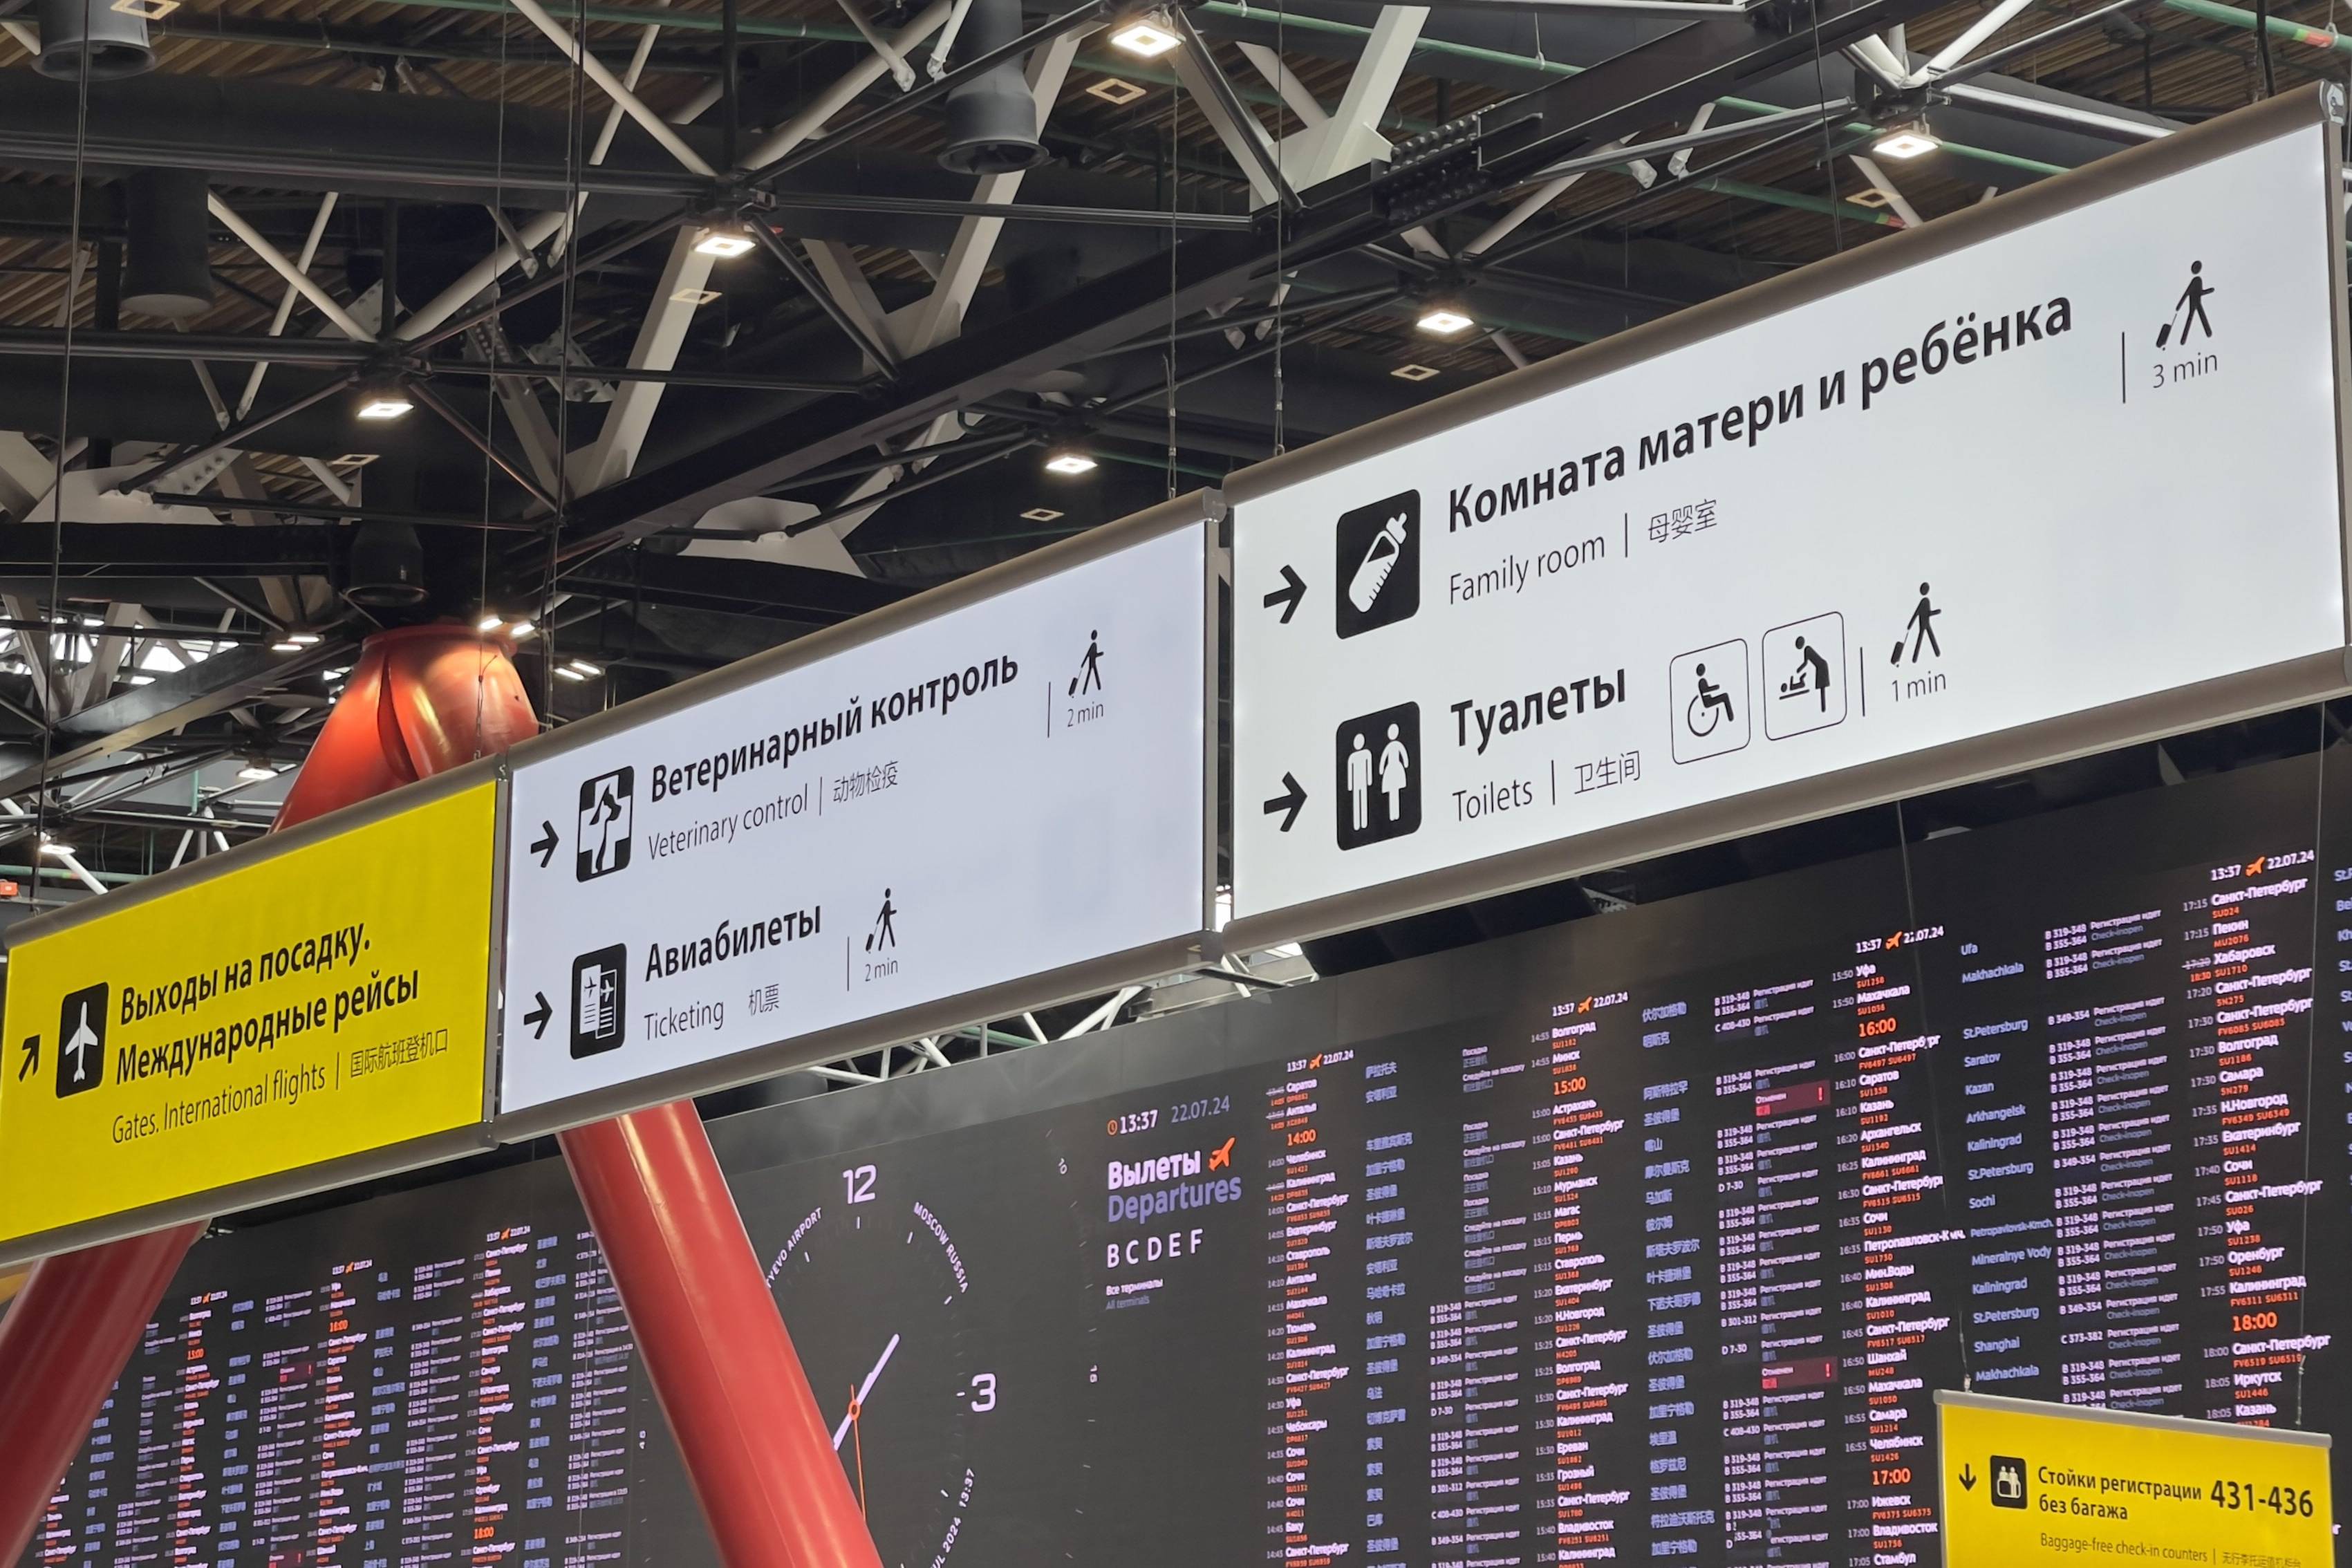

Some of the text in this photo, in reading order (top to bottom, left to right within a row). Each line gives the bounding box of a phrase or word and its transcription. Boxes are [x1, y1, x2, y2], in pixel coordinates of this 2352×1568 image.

[2154, 353, 2216, 388] 3 min
[1450, 297, 2071, 532] Комната матери и ребёнка
[1648, 499, 1717, 543] 母婴室
[1451, 536, 1604, 604] Family room
[1892, 671, 1945, 701] 1 min
[1067, 702, 1103, 727] 2 min
[1451, 669, 1625, 746] Туалеты
[652, 655, 1018, 802] Ветеринарный контроль
[834, 761, 898, 802] 动物检疫
[1575, 751, 1640, 794] 卫生间
[1453, 780, 1532, 821] Toilets
[648, 784, 807, 859] Veterinary control
[2211, 850, 2314, 880] 13:37 22.07.24
[2183, 879, 2308, 911] 17:15 Санкт-Петербург
[646, 906, 820, 982] Авиабилеты
[1856, 939, 1881, 953] 13:37
[1961, 943, 1977, 955] Ufa
[2214, 945, 2275, 964] Хабаровск
[121, 923, 369, 1025] Выходы на посадку.
[866, 958, 897, 982] 2 min
[1856, 964, 1876, 978] Уфа
[1857, 985, 1910, 1003] Махачкала
[2187, 968, 2312, 999] 17:20 Санкт-Петербург
[749, 984, 779, 1015] 机票
[1553, 992, 1627, 1016] 13:37 22.07.24
[2216, 998, 2313, 1023] Санкт-Петербург
[117, 970, 418, 1085] Международные рейсы
[644, 1001, 723, 1040] Ticketing
[1860, 1018, 1896, 1037] 16:00
[351, 1029, 447, 1078] 国际航班登机口
[2218, 1035, 2279, 1053] Волгоград
[1323, 1050, 1354, 1065] 22.07.24
[1964, 1054, 2000, 1067] Saratov
[1554, 1077, 1586, 1095] 15:00
[1859, 1071, 1899, 1086] Саратов
[2219, 1067, 2264, 1083] Самара
[1966, 1083, 1994, 1095] Kazan
[113, 1063, 325, 1143] Gates. International flights
[1121, 1096, 1229, 1134] 13:37 22.07.24
[1288, 1130, 1316, 1146] 14:00
[2222, 1122, 2301, 1142] Екатеринбург
[1108, 1151, 1200, 1190] Вылеты
[2223, 1160, 2252, 1173] Сочи
[843, 1165, 877, 1204] 12
[2197, 1181, 2323, 1206] 17:45 Санкт-Петербург
[1108, 1177, 1241, 1224] Departures
[787, 1207, 822, 1251] AIRPORT
[2199, 1220, 2250, 1236] 17:50 Уфа
[913, 1202, 968, 1293] MOSCOW RUSSIA
[1108, 1229, 1202, 1267] B C D E F
[2026, 1246, 2051, 1258] Vody
[2200, 1247, 2284, 1267] 17:50 Оренбург
[2230, 1276, 2306, 1294] Калининград
[1867, 1317, 1950, 1336] Санкт-Петербург
[2233, 1312, 2277, 1331] 18:00
[1975, 1337, 2019, 1352] Shanghai
[2232, 1335, 2331, 1354] Санкт-Петербург
[971, 1373, 996, 1412] 3
[2205, 1372, 2281, 1388] 18:05 Иркутск
[1869, 1408, 1907, 1421] Самара
[2207, 1404, 2277, 1419] 18:05 Казань
[1873, 1468, 1910, 1485] 17:00
[2038, 1466, 2313, 1517] Стойки регистрации 431-436
[943, 1517, 961, 1553] 2024
[959, 1468, 974, 1507] 13:37
[2040, 1495, 2127, 1520] без багажа
[1874, 1552, 1916, 1566] Стамбул
[2041, 1533, 2208, 1562] Baggage-free check-in counters
